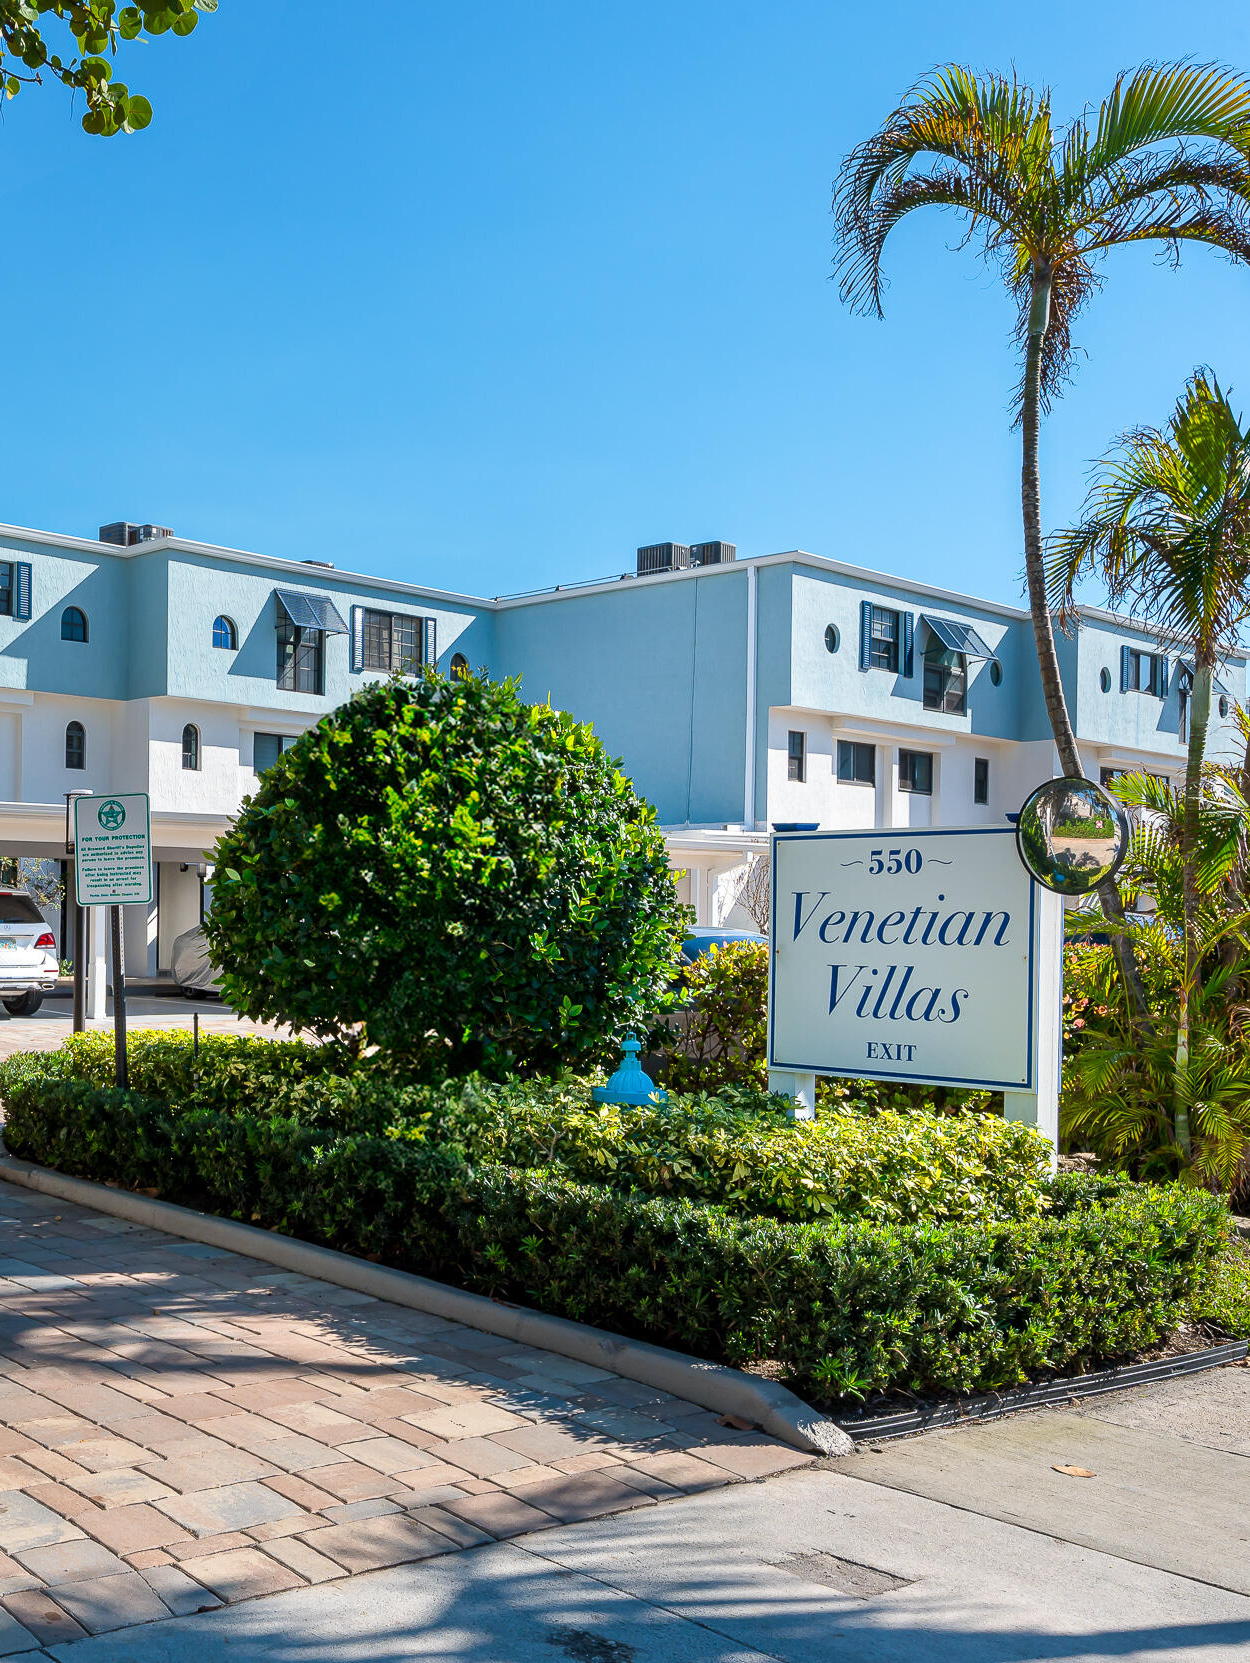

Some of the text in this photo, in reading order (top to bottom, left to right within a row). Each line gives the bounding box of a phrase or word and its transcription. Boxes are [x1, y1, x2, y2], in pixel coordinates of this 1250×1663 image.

[869, 848, 923, 875] 550
[791, 891, 1011, 947] Venetian
[827, 964, 969, 1023] Villas
[866, 1041, 917, 1062] EXIT
